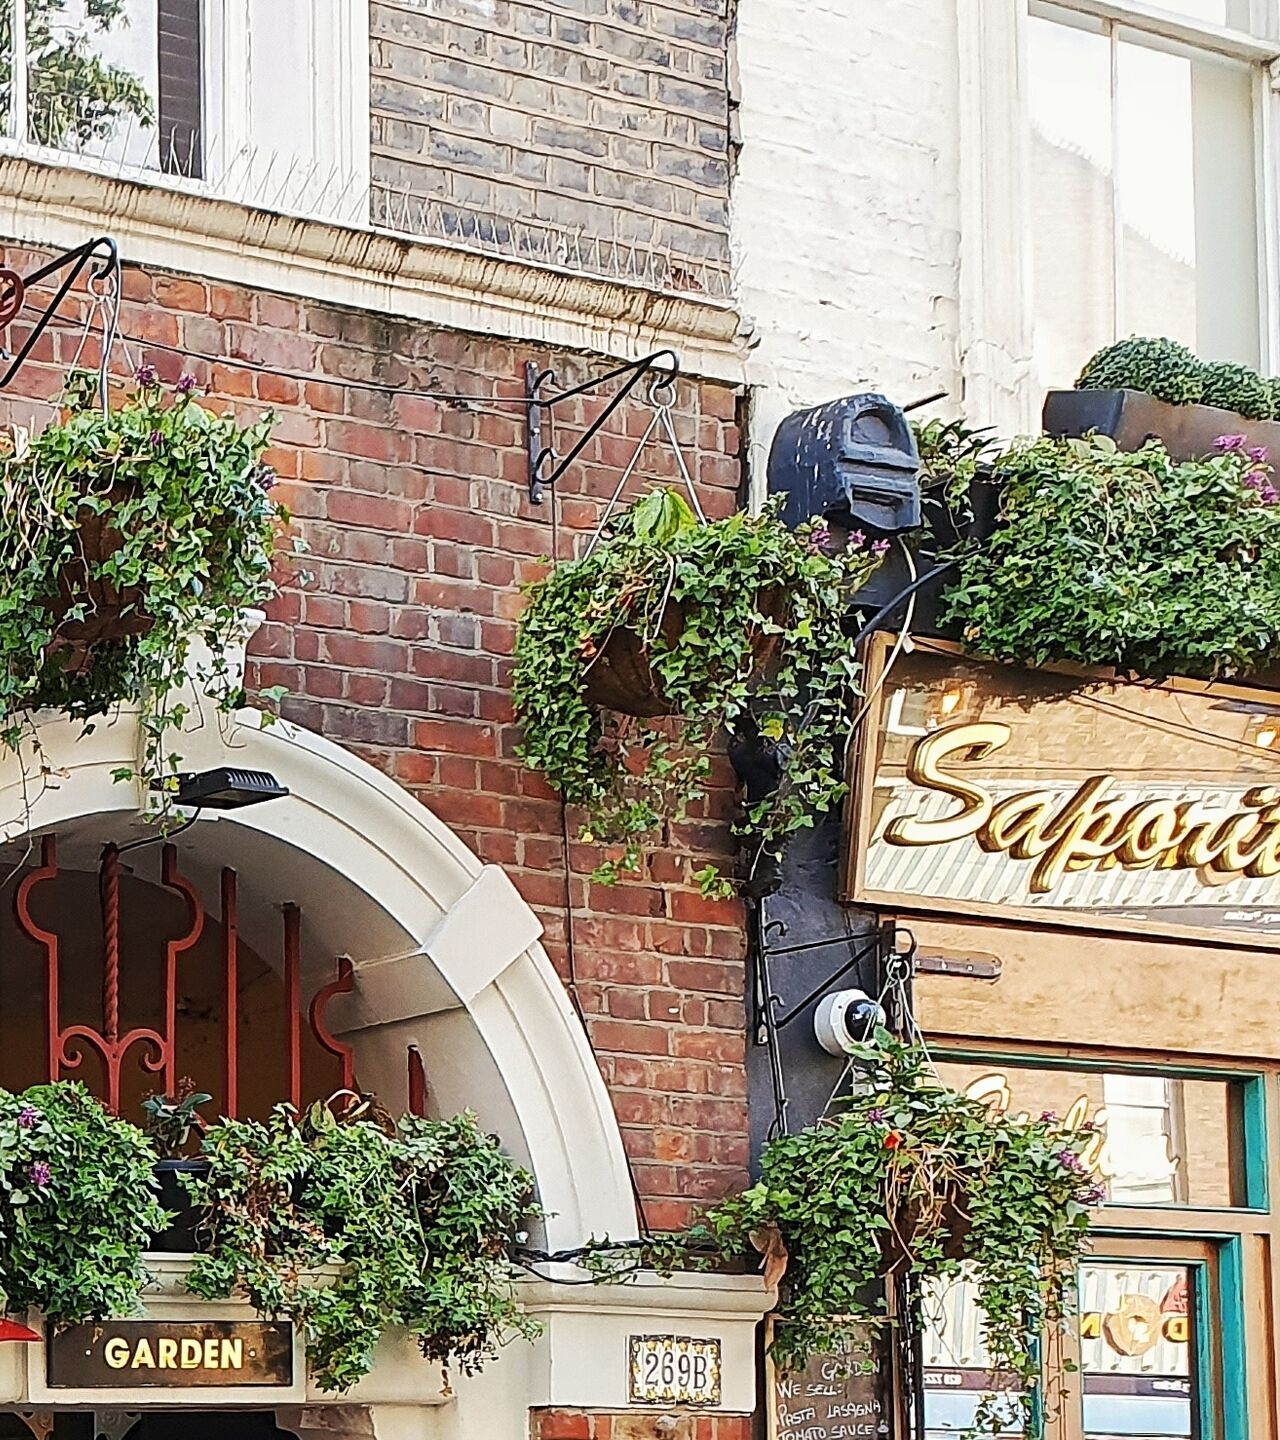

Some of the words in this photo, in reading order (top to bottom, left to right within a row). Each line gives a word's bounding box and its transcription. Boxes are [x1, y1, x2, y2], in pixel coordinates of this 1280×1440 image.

[105, 1337, 243, 1370] GARDEN
[645, 1351, 708, 1390] 269B
[778, 1404, 816, 1427] PASTA
[826, 1400, 881, 1418] LASAGNA
[830, 1424, 875, 1438] SAUCE
